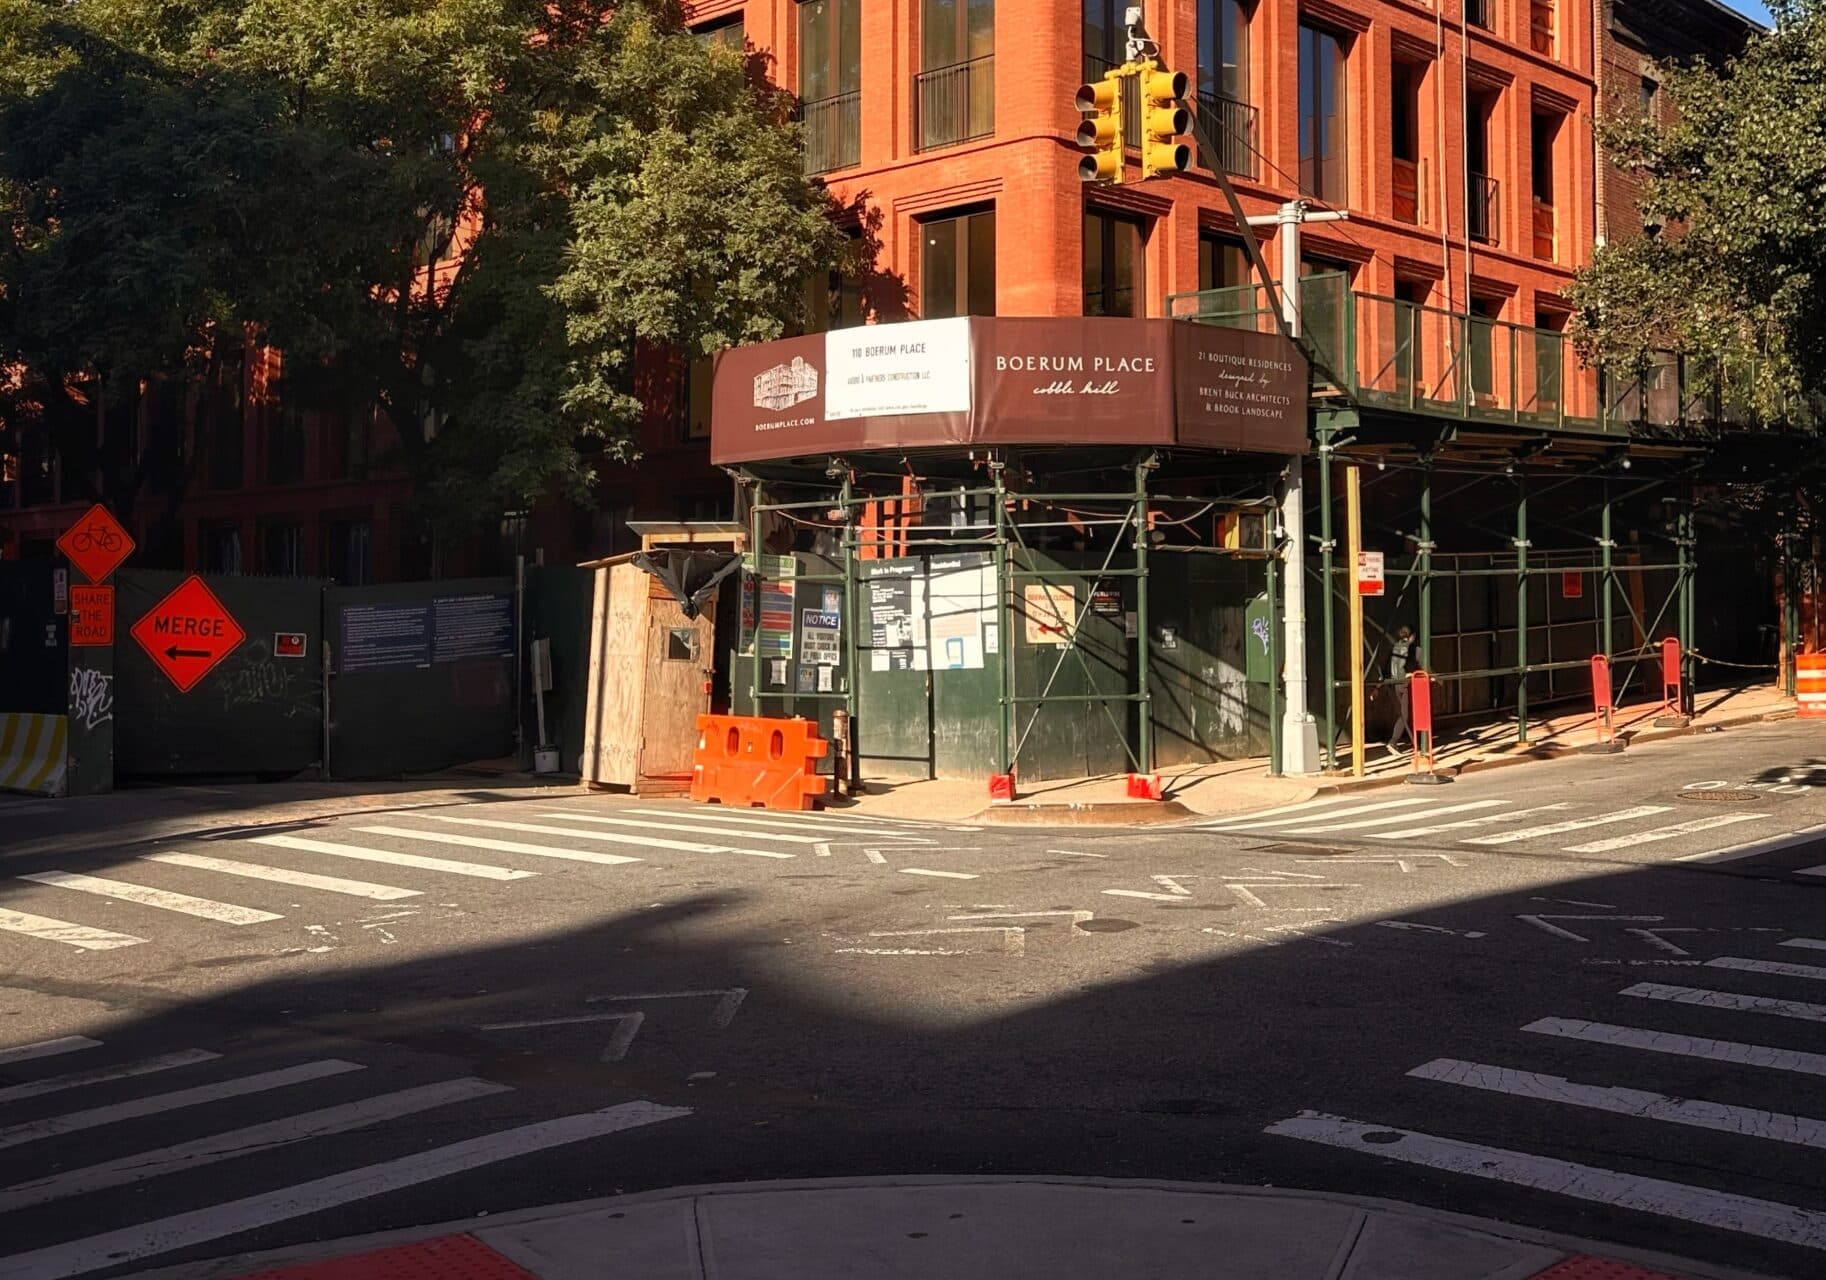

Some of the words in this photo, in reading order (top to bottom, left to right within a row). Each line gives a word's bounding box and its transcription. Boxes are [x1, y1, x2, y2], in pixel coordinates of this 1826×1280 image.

[852, 348, 862, 359] 110
[865, 344, 896, 357] BOERUM
[900, 343, 926, 355] PLACE
[996, 356, 1084, 371] BOERUM
[1094, 357, 1155, 372] PLACE
[1198, 352, 1206, 360] 21
[1208, 353, 1246, 366] BOUTIQUE
[1248, 358, 1292, 371] RESIDENCES
[1033, 380, 1075, 394] cobble
[1079, 380, 1121, 394] hill
[1199, 387, 1222, 397] BRENT
[1224, 390, 1244, 400] BUCK
[1246, 393, 1290, 405] ARCHITECTS
[1214, 403, 1239, 414] BROOK
[1241, 406, 1283, 419] LANDSCAPE
[755, 417, 815, 432] BOERUMPLACE.COM
[75, 593, 110, 605] SHARE
[82, 610, 102, 621] THE
[805, 613, 837, 626] NOTICE
[76, 626, 107, 637] ROAD
[155, 616, 225, 637] MERGE
